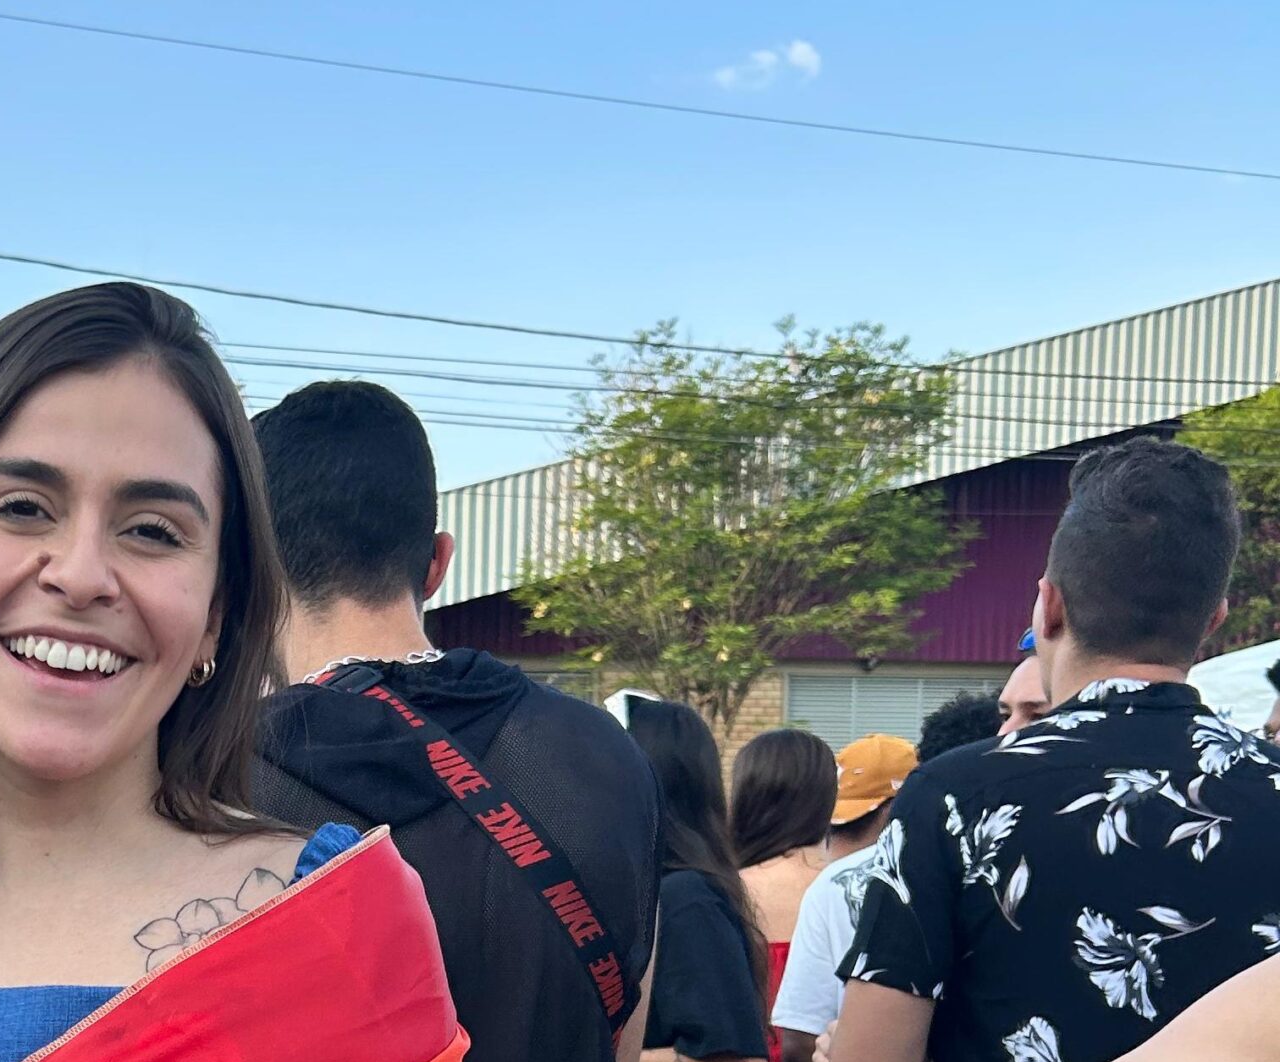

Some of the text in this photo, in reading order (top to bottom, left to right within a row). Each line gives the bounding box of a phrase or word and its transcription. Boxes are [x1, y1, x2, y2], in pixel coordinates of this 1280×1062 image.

[426, 739, 492, 800] NIKE
[475, 802, 552, 868] NIKE
[542, 880, 606, 948] NIKE
[587, 951, 625, 1017] NIKE
